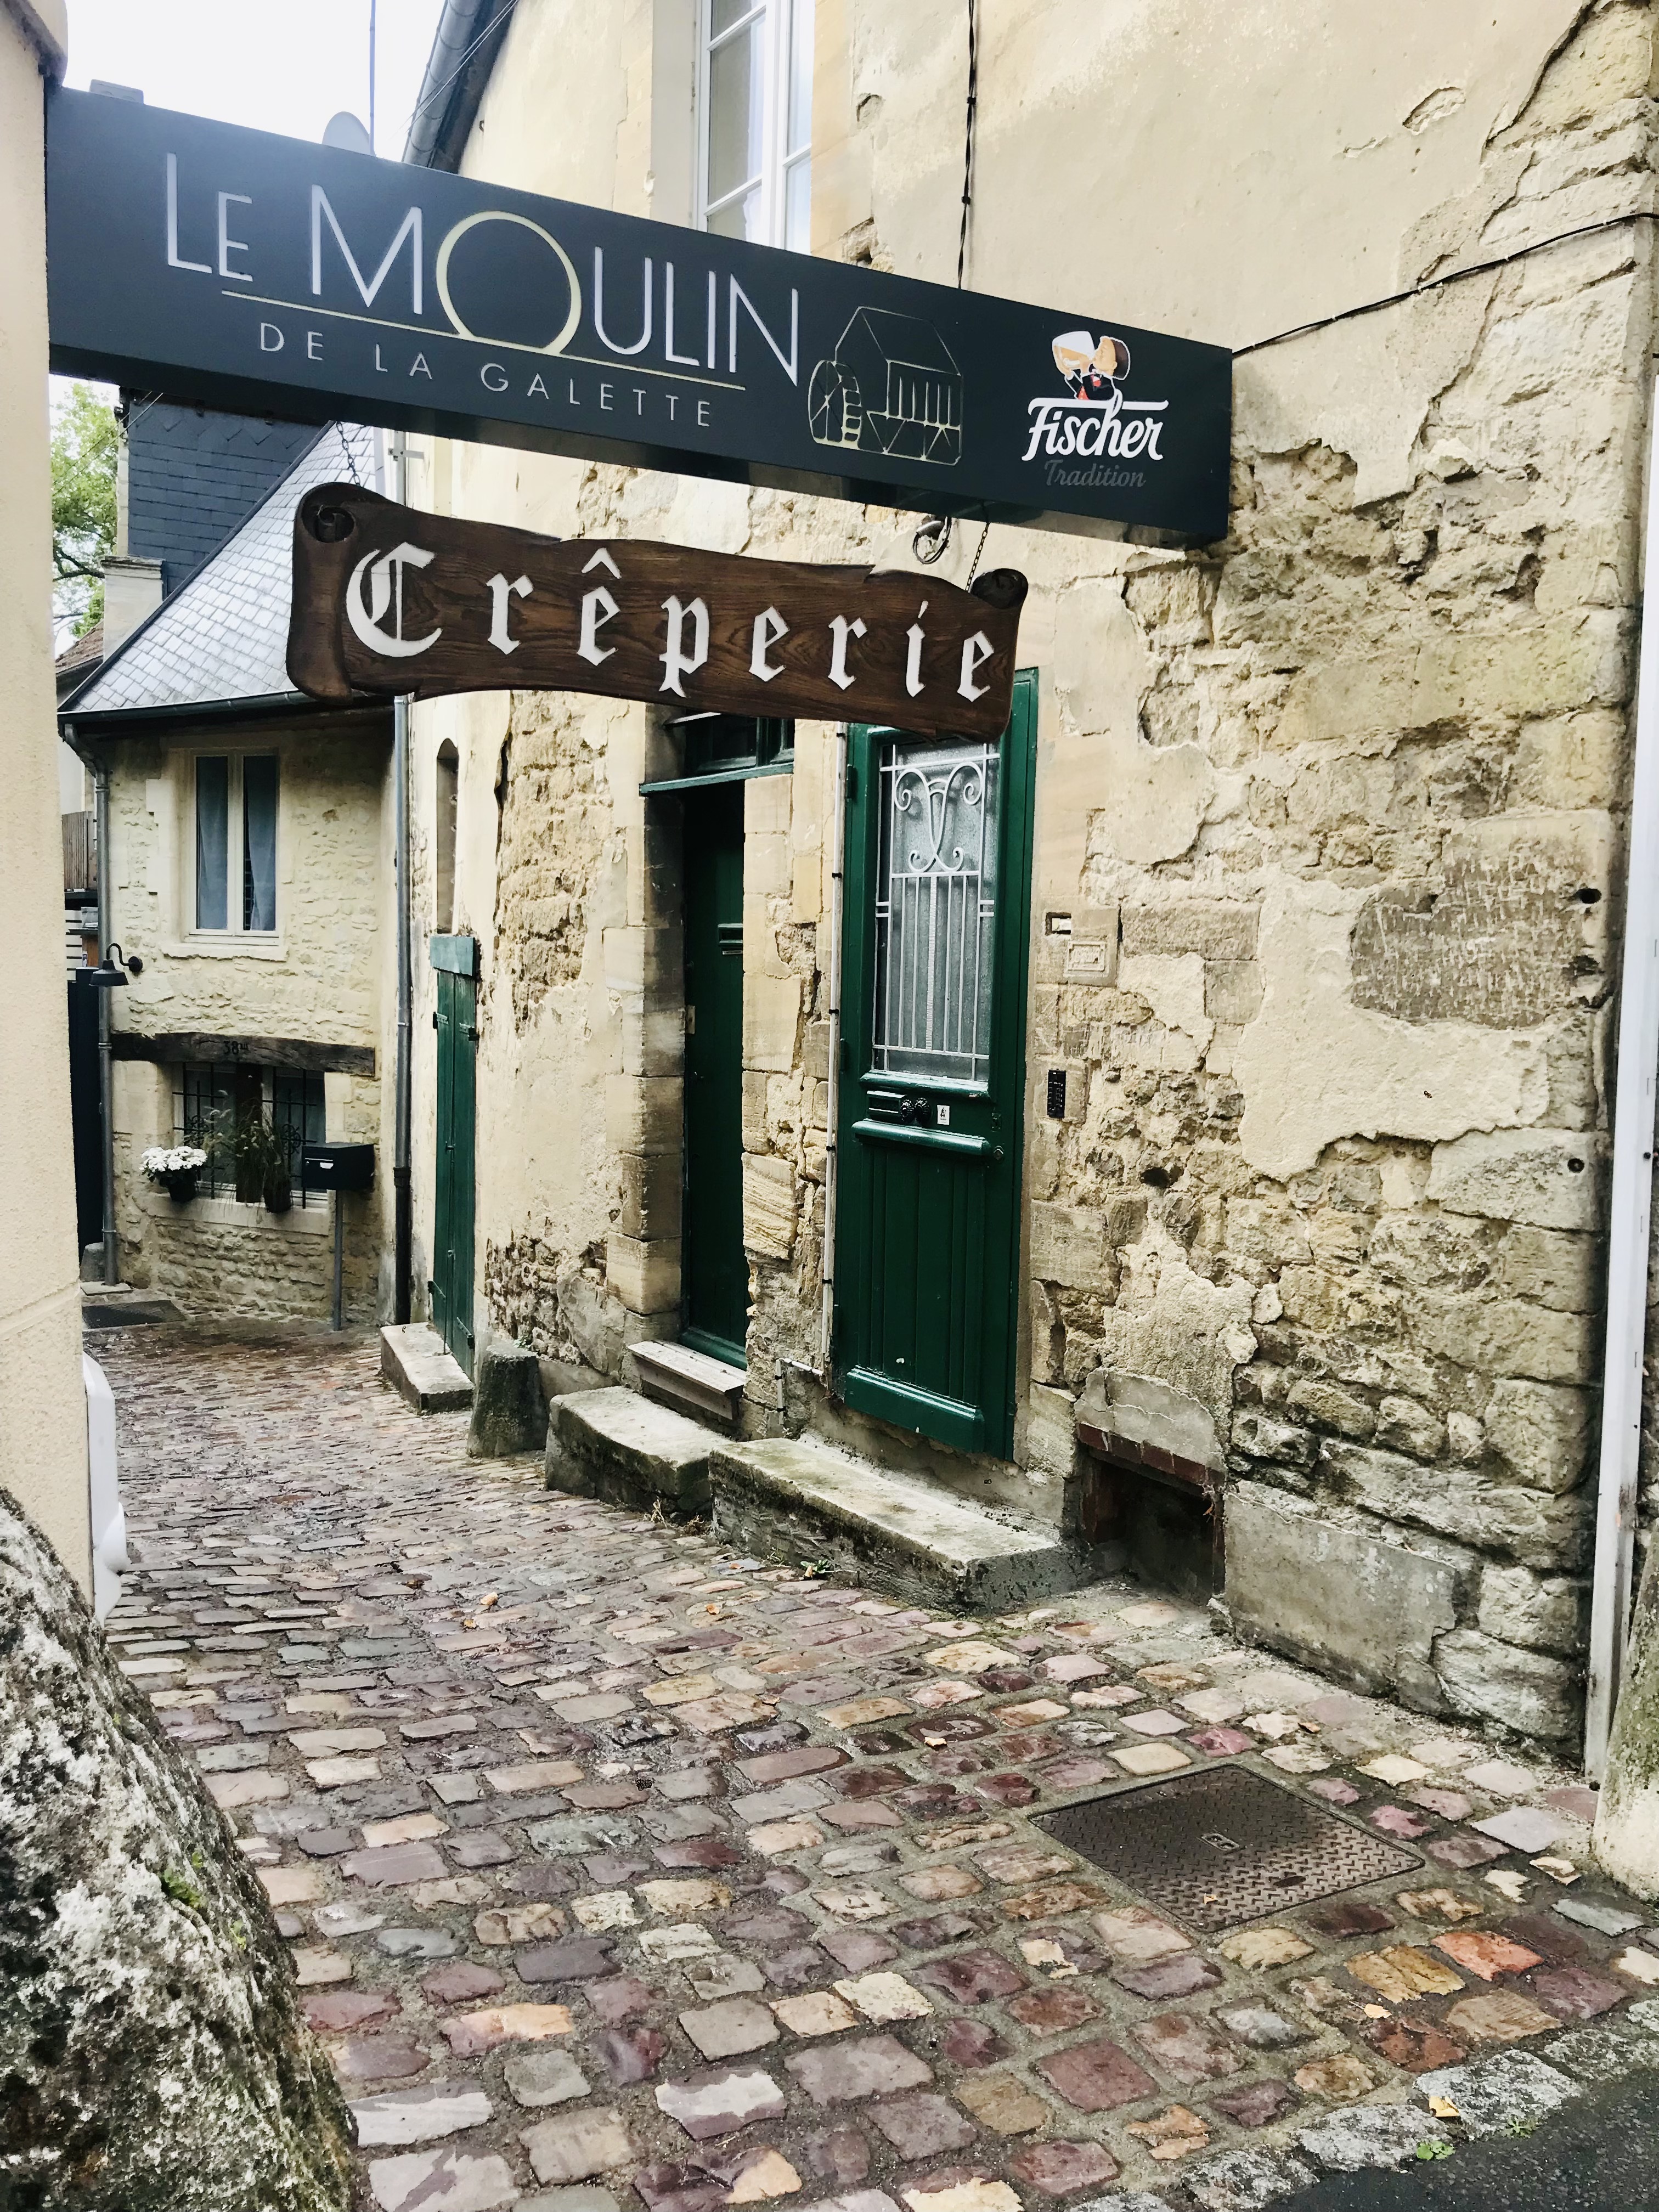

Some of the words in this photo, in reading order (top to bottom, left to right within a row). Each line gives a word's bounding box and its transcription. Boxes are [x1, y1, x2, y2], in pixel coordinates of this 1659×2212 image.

[166, 153, 253, 282] LE
[311, 184, 799, 387] MOULIN
[260, 322, 323, 361] DE
[375, 343, 433, 380] LA
[480, 363, 710, 427] GALETTE
[1022, 390, 1169, 461] Fischer
[1044, 459, 1146, 488] Tradition
[346, 541, 995, 702] Crêperie
